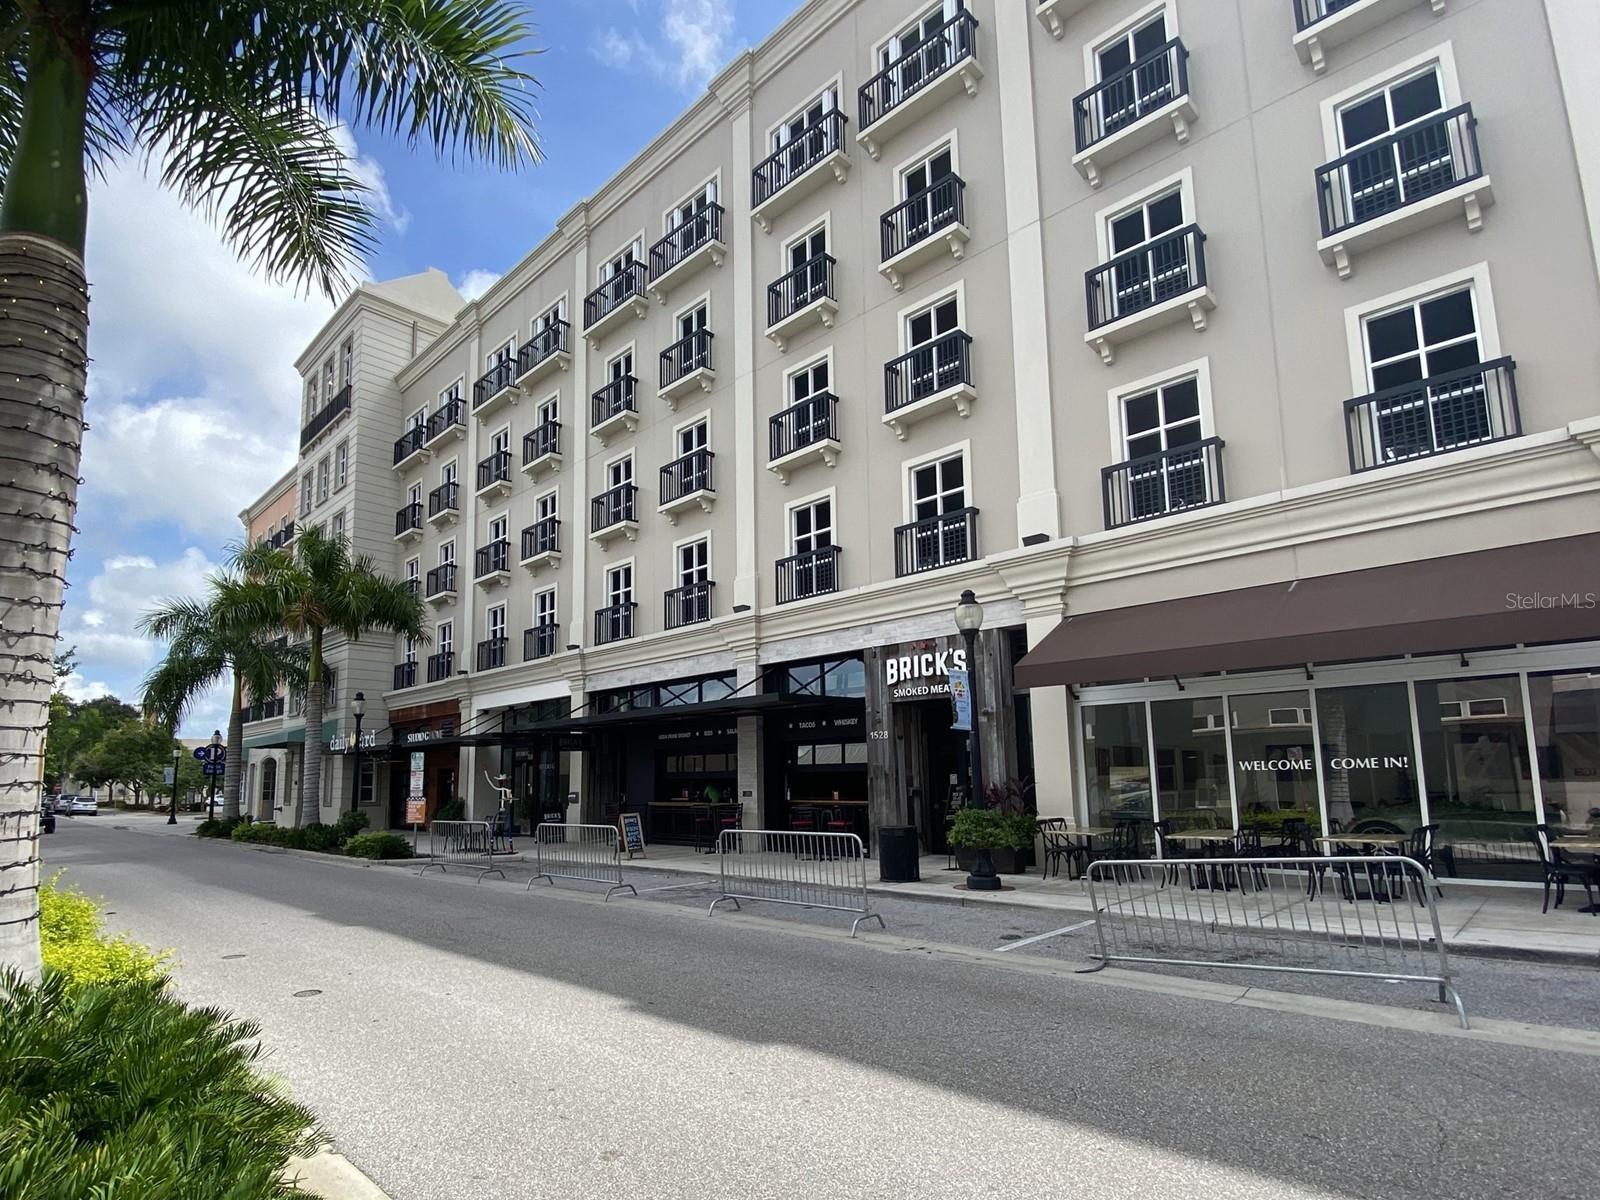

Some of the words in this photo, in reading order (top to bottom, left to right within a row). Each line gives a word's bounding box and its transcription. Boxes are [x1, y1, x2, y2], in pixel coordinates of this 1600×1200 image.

[886, 648, 967, 686] BRICK'S
[893, 686, 929, 698] SMOKED
[930, 683, 951, 695] MEA
[870, 731, 889, 740] 1528
[329, 734, 350, 754] daily
[1239, 759, 1313, 771] WELCOME
[1330, 757, 1379, 770] COME
[1383, 756, 1409, 769] IN!
